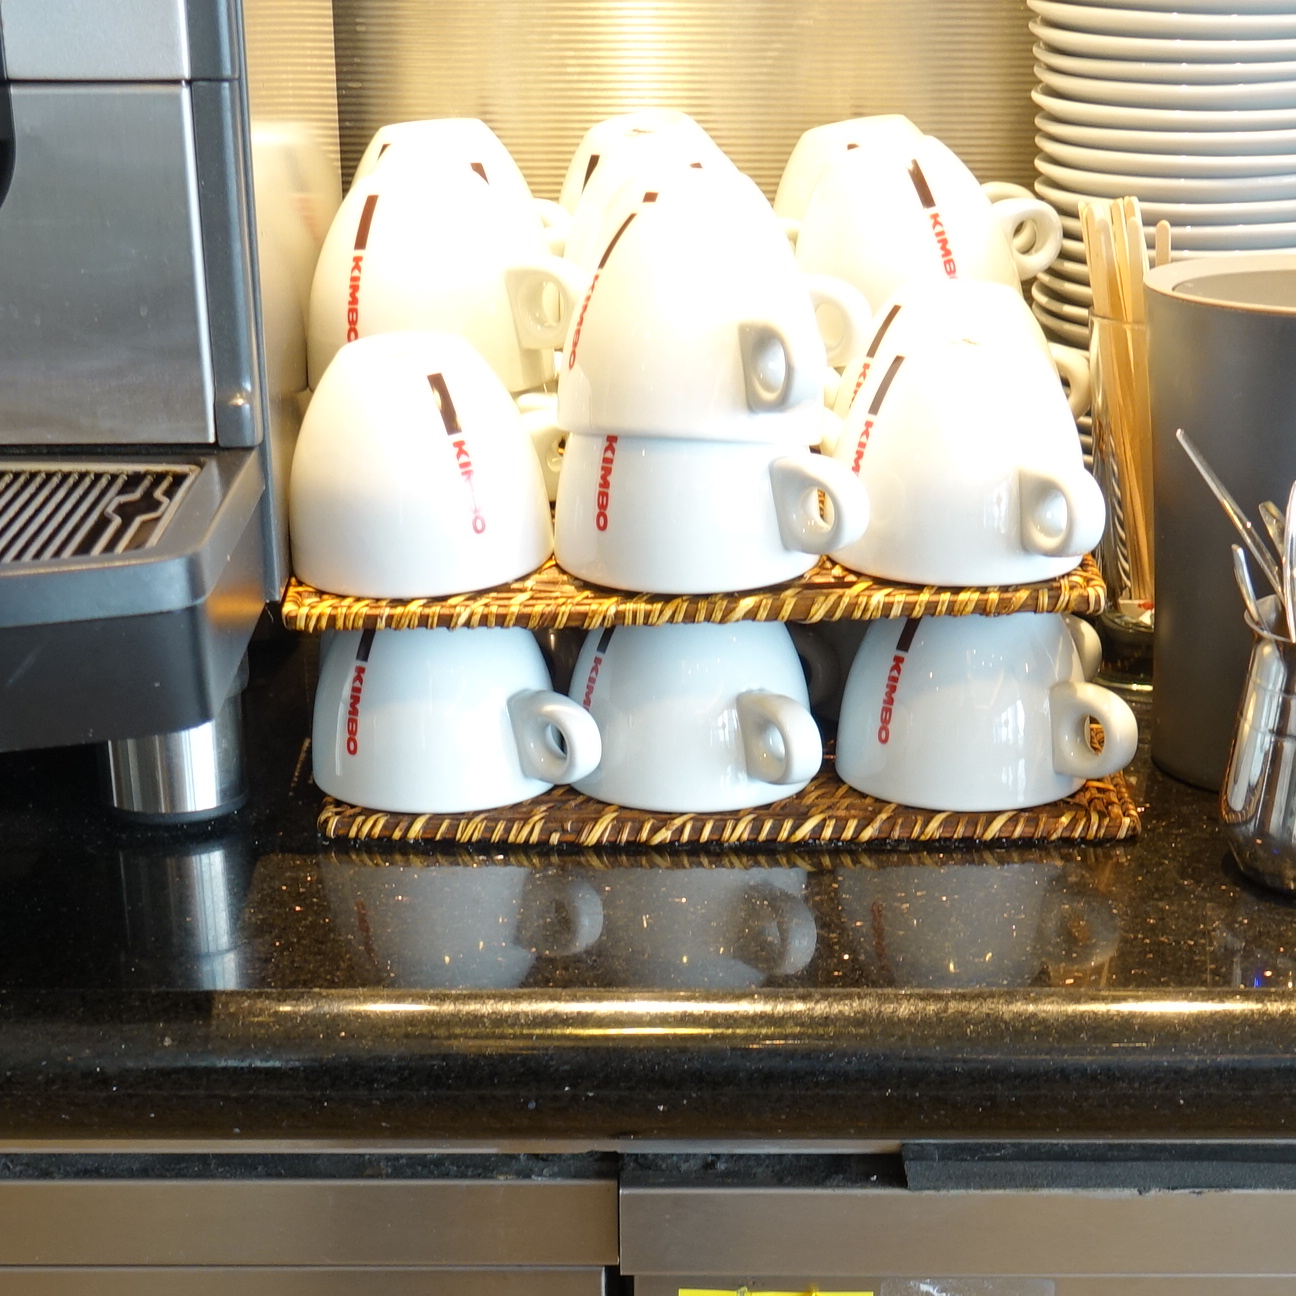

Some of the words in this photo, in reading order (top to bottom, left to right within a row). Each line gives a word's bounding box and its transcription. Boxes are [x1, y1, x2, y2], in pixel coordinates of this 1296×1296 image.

[595, 435, 618, 531] KIMBO
[345, 666, 366, 756] KIMBO
[876, 654, 905, 744] KIMBO
